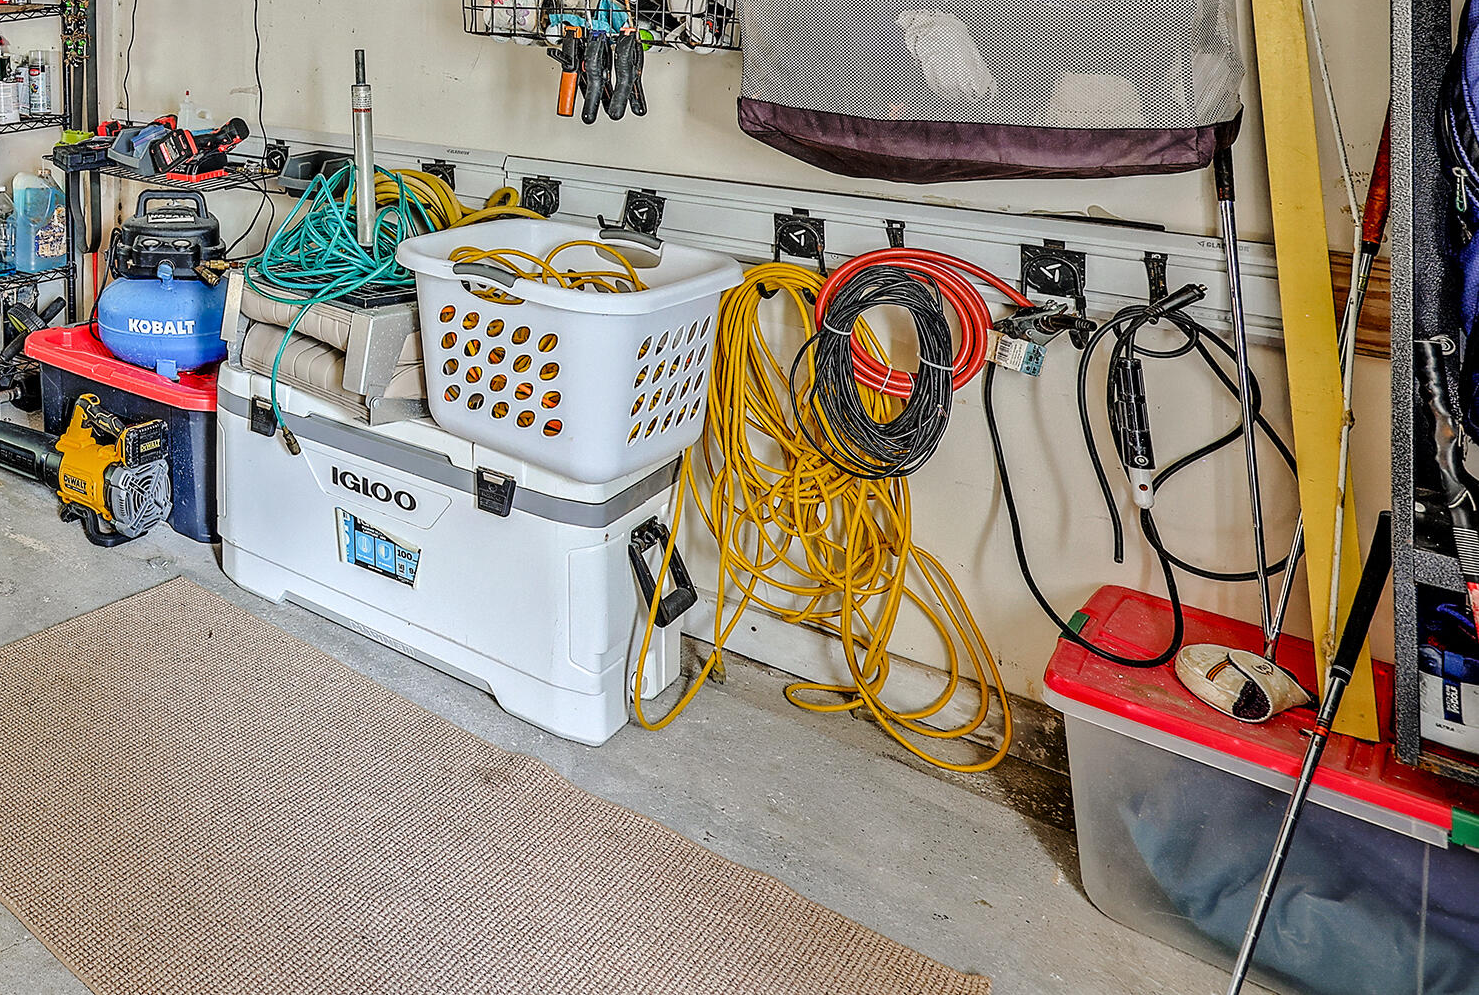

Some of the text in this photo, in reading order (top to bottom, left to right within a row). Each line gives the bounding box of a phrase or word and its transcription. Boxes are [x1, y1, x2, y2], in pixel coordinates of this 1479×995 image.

[128, 318, 196, 336] KOBALT
[331, 466, 417, 512] IGLOO
[397, 549, 413, 561] 100
